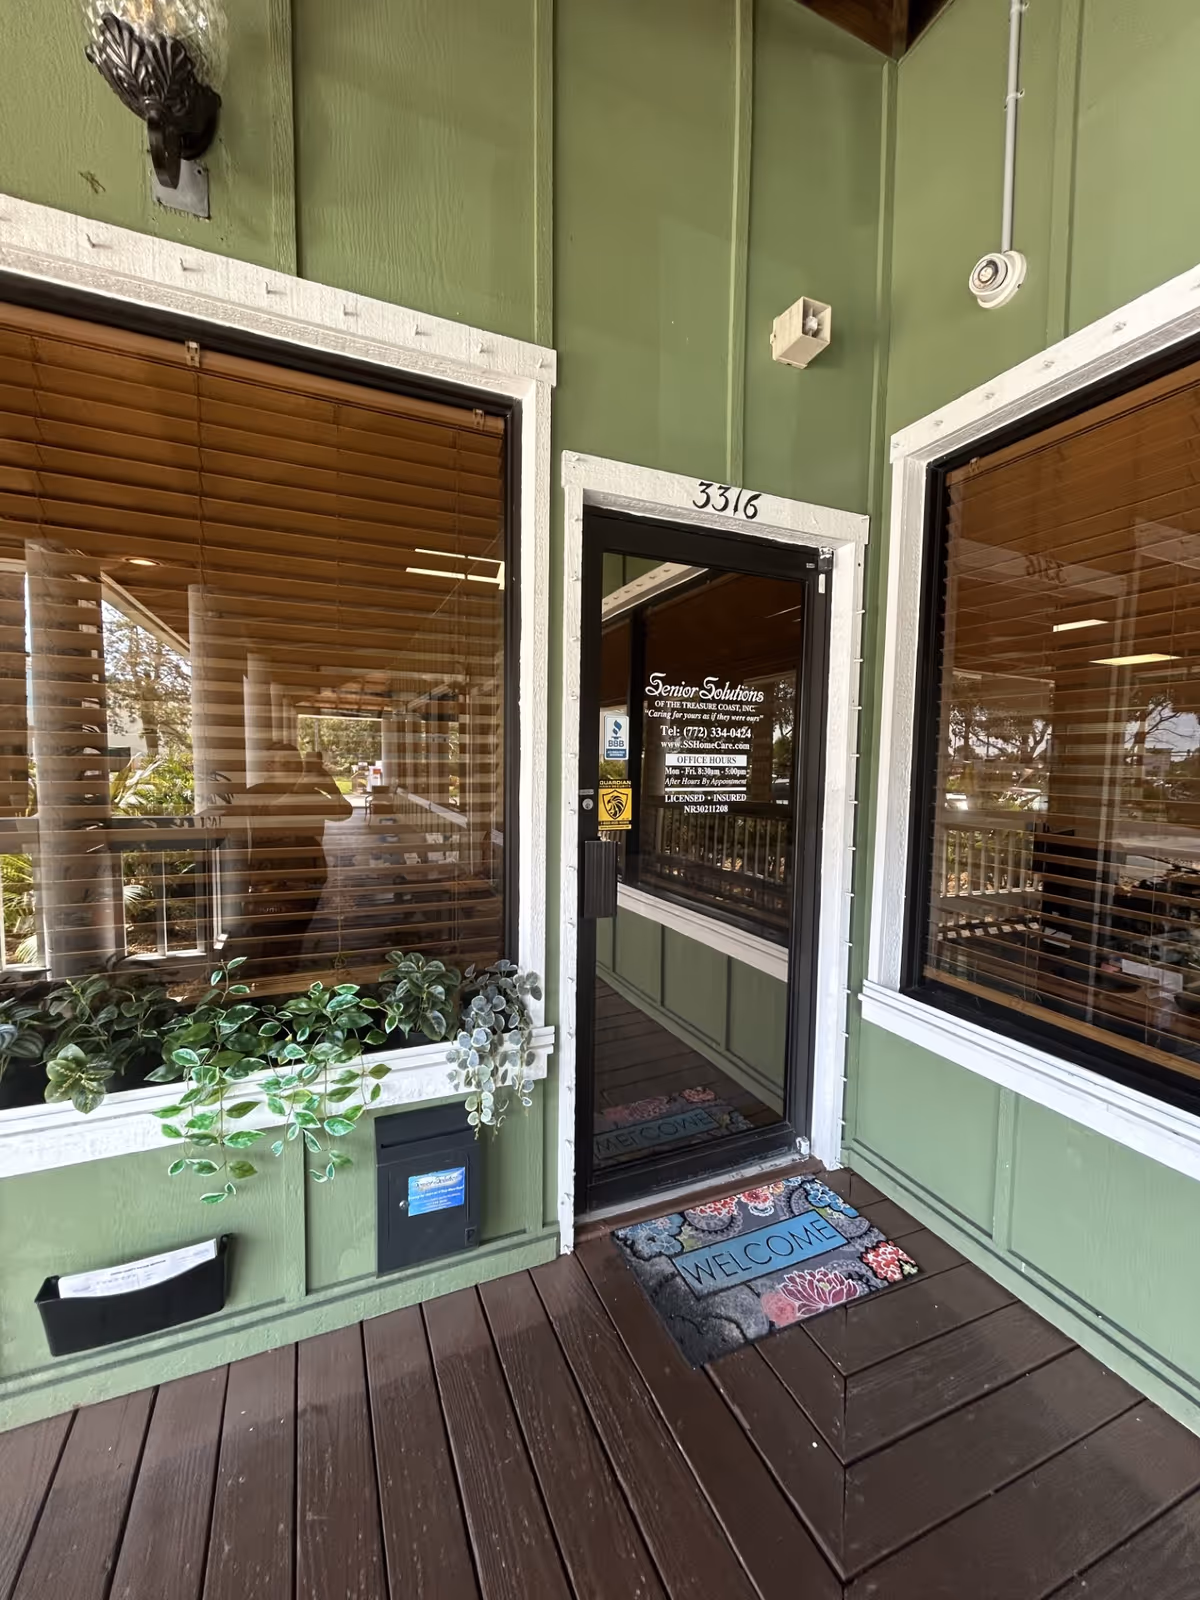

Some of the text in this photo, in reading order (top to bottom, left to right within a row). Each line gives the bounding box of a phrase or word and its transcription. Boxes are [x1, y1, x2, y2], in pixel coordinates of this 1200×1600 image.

[692, 481, 762, 519] 3316
[645, 672, 764, 702] Senior Solutions
[655, 700, 665, 708] OF
[682, 701, 717, 710] TREASURE
[718, 703, 741, 712] COAST,
[742, 704, 756, 712] INC.
[672, 711, 682, 720] for
[683, 712, 701, 721] yours
[711, 712, 717, 721] if
[717, 713, 730, 722] they
[660, 725, 751, 738] Tel: (772) 334-0424
[661, 740, 750, 750] www.SSHomeCare.com
[677, 756, 737, 764] OFFICE HOURS
[665, 767, 680, 775] Mon
[685, 767, 696, 775] Fri.
[725, 768, 746, 776] 5:00pm
[665, 778, 680, 786] After
[701, 778, 710, 786] By
[710, 778, 747, 787] Appointment
[665, 794, 746, 803] LICENSED INSURED
[684, 805, 728, 814] NR30211208
[681, 1219, 838, 1285] WELCOME
